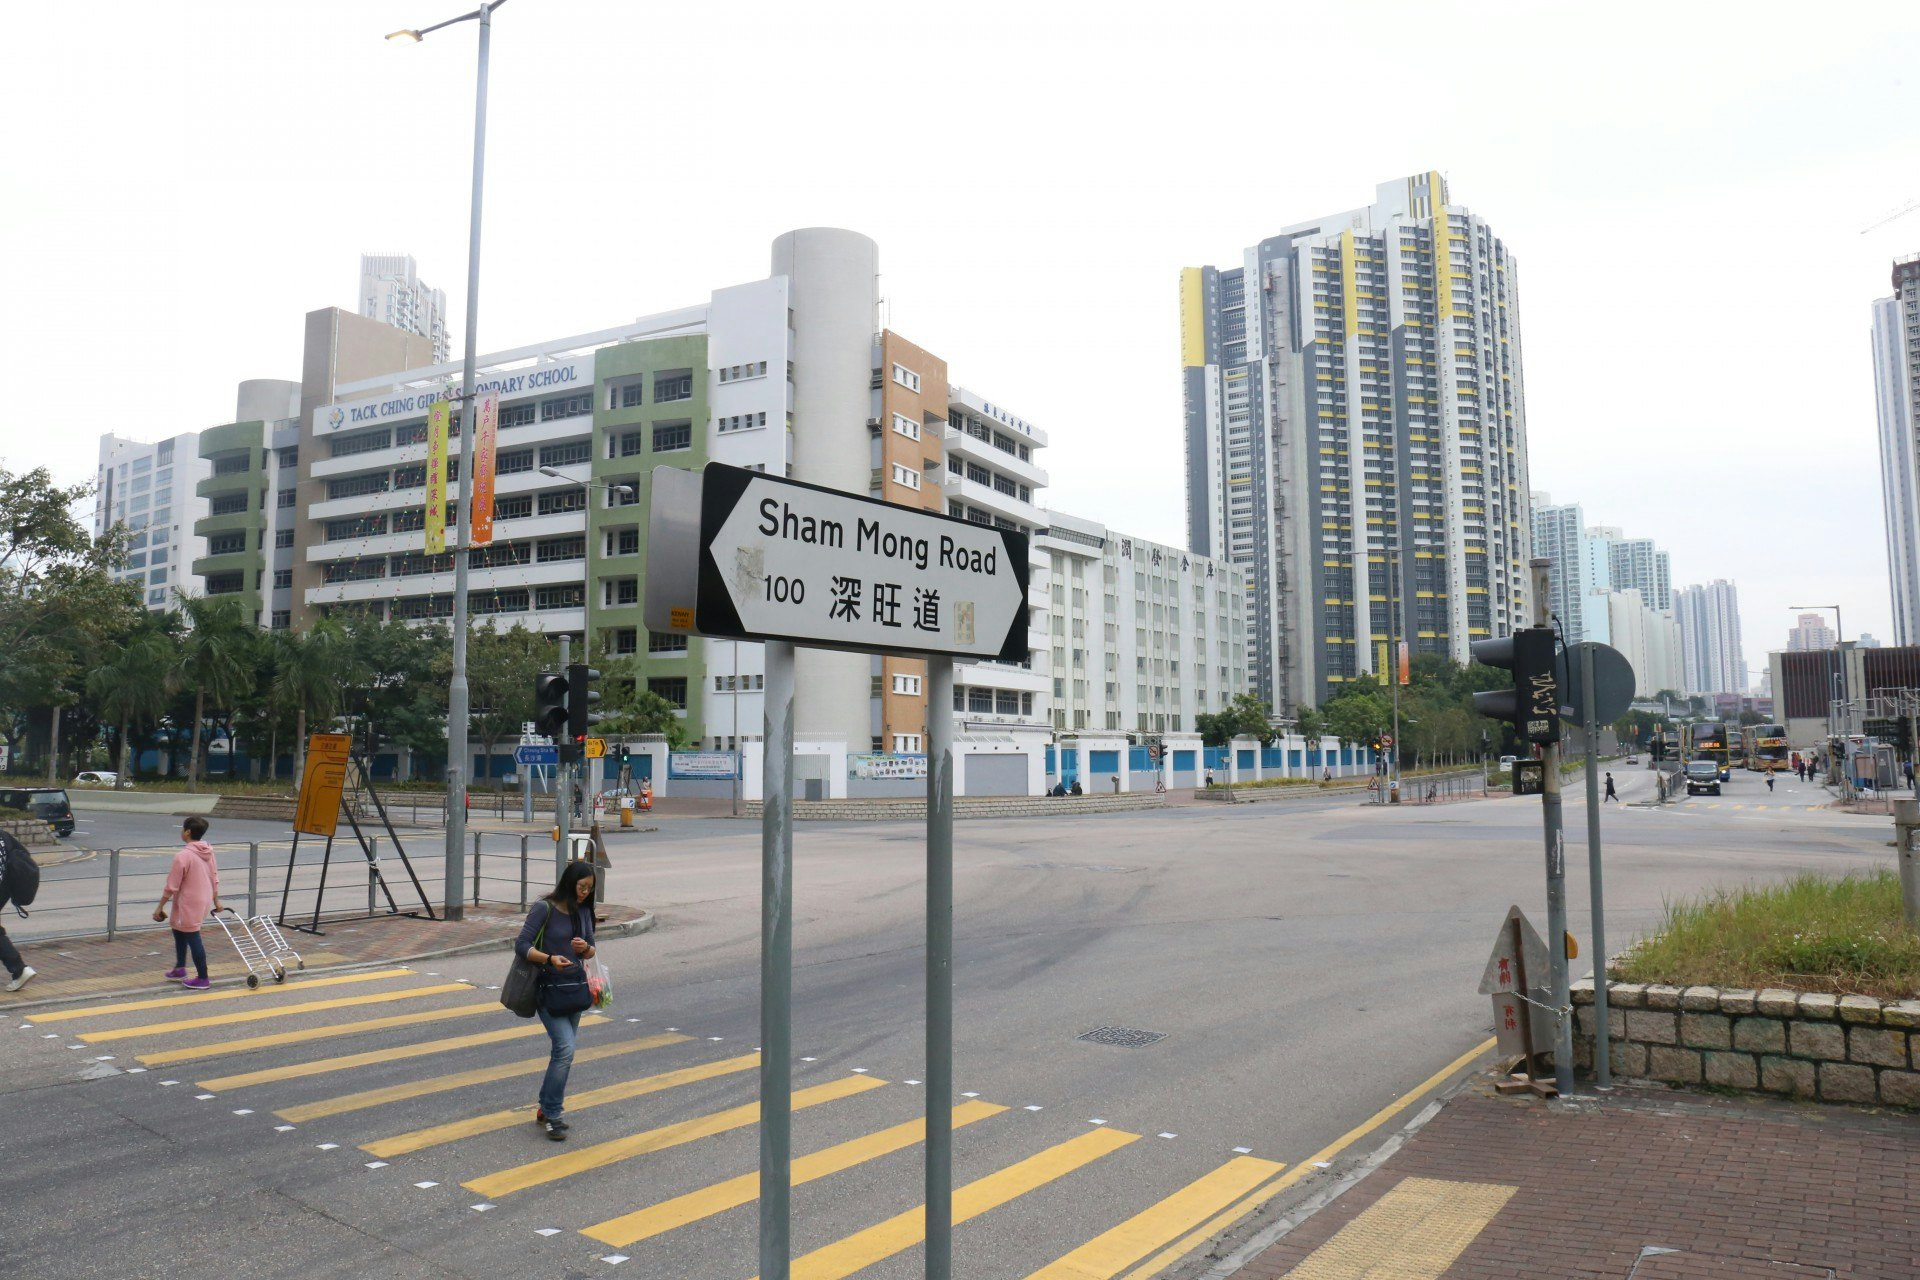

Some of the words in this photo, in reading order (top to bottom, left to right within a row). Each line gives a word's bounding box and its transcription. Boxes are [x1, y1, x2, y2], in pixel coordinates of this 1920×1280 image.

[351, 404, 377, 422] TACK
[381, 397, 414, 416] CHING
[456, 375, 525, 402] SONDARY
[528, 366, 577, 389] SCHOOL
[758, 497, 843, 549] Sham
[856, 517, 929, 570] Mong
[940, 534, 996, 576] Road
[764, 574, 805, 605] 100
[829, 575, 941, 633] 深旺道
